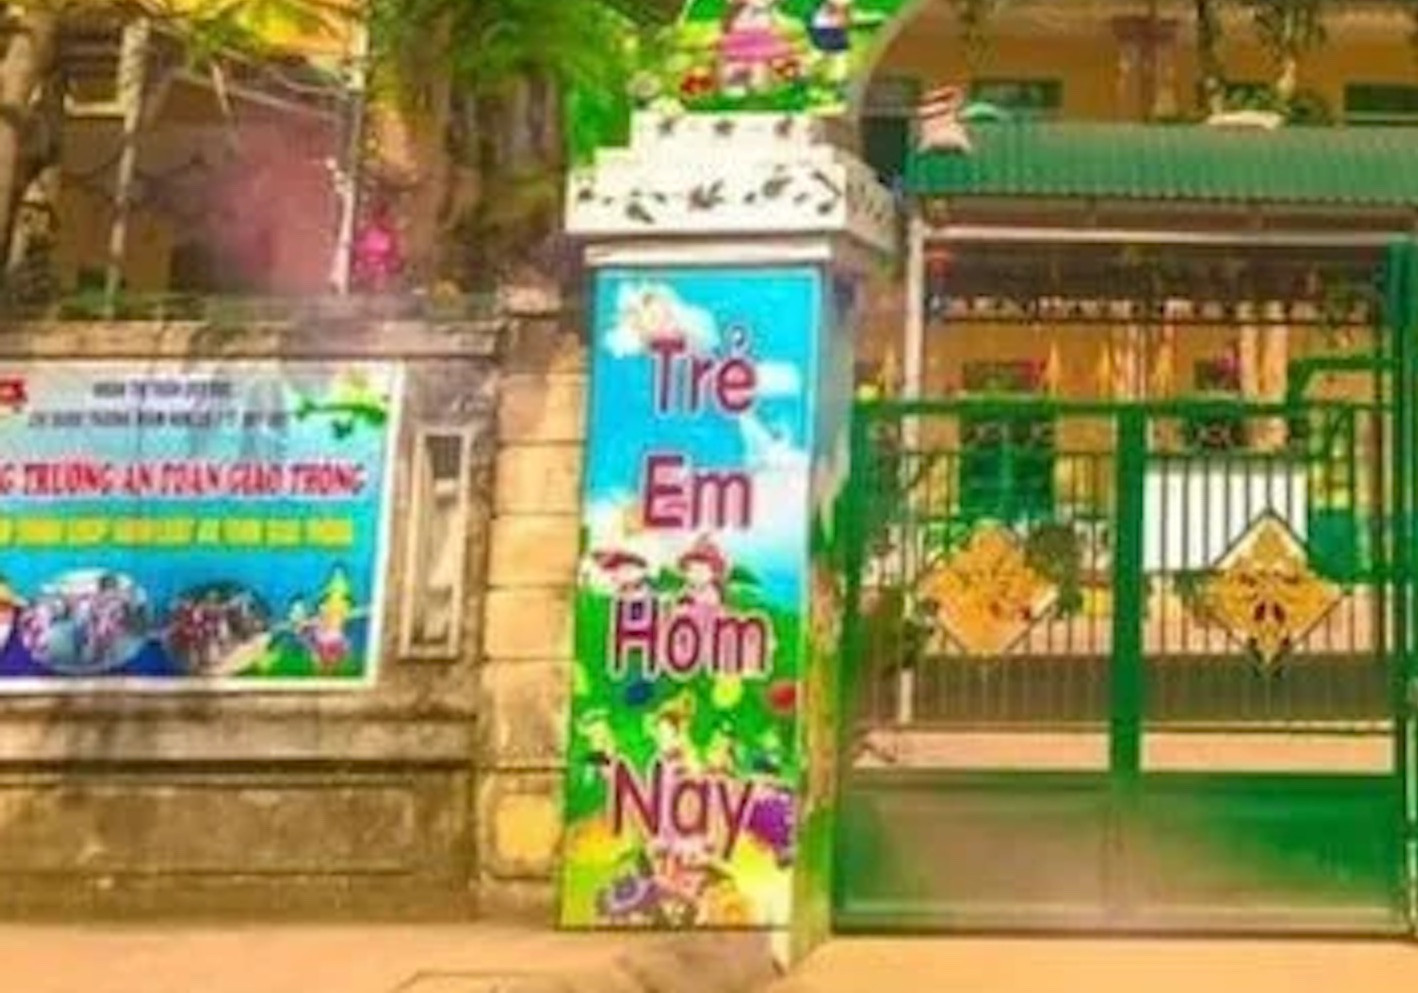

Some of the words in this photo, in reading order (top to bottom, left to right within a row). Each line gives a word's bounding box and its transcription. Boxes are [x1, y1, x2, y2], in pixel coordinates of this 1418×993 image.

[651, 322, 758, 416] Trẻ
[642, 454, 752, 530] Em
[613, 760, 756, 861] Nay
